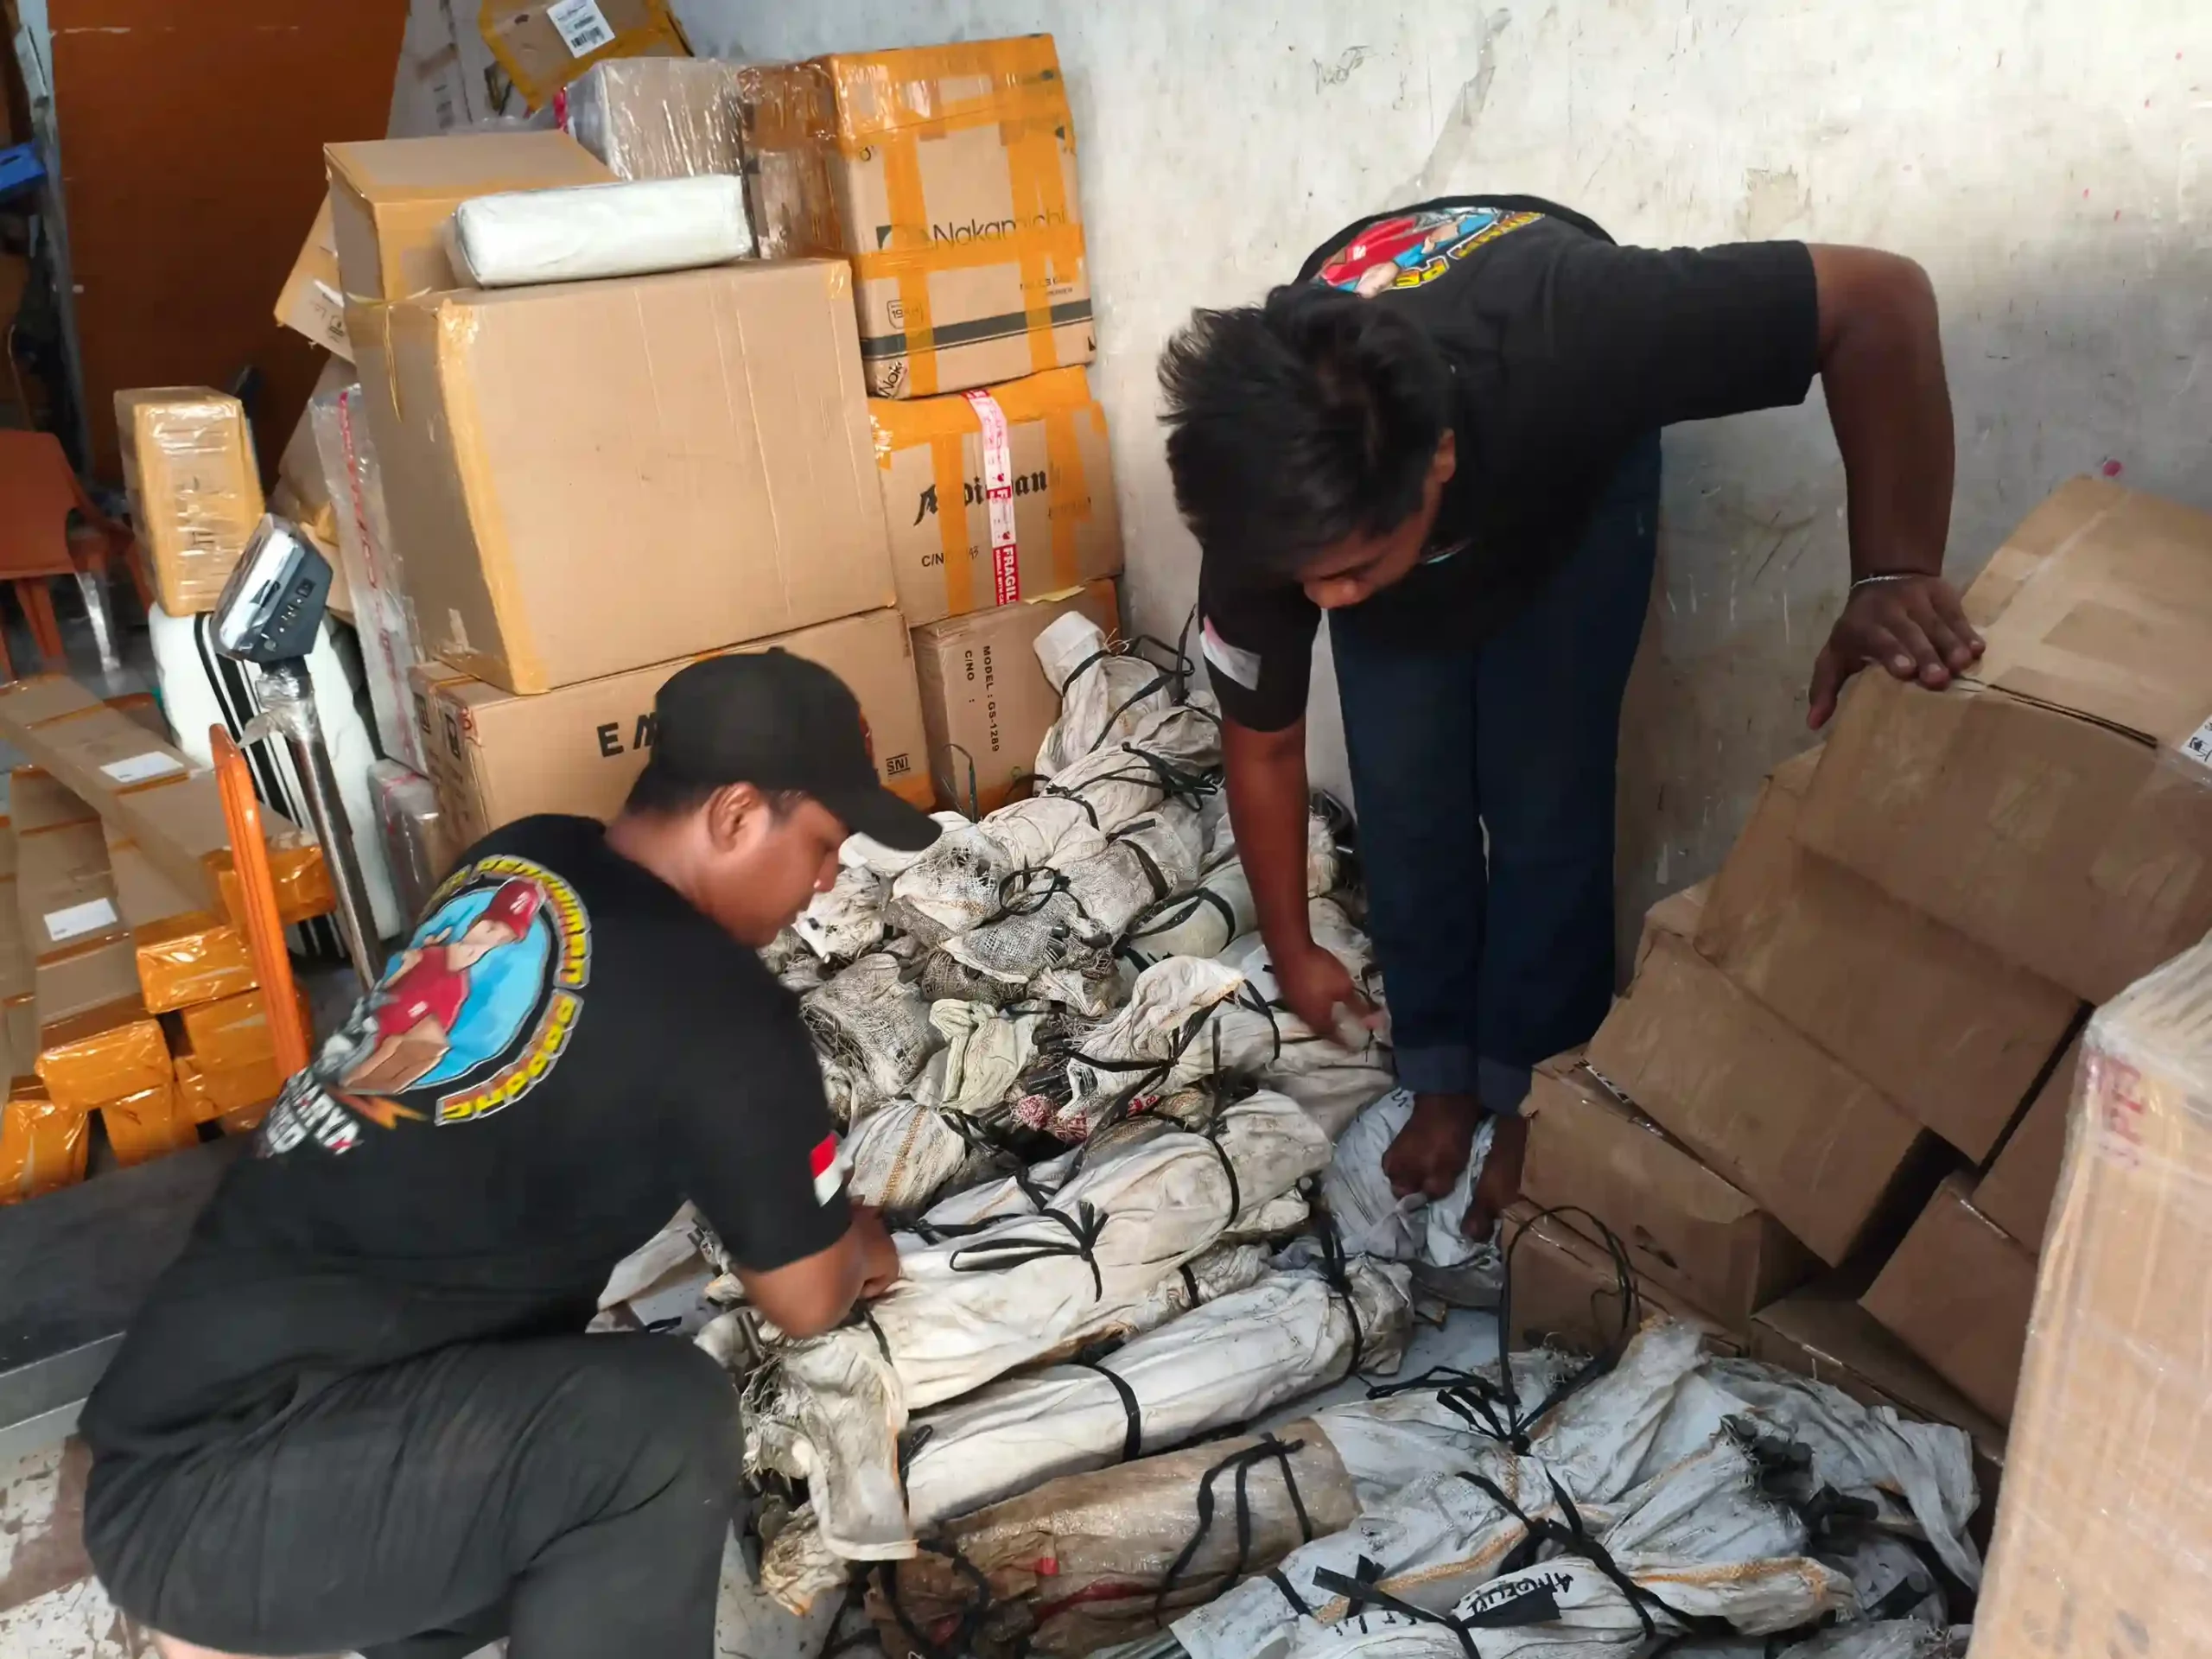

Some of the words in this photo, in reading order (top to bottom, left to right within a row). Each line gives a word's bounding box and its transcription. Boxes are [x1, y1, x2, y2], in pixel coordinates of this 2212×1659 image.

[1002, 546, 1017, 603] FRAGIL
[964, 650, 975, 681] C/NO
[983, 645, 994, 690] MODEL
[988, 701, 1000, 753] GS-1289
[887, 756, 908, 772] SNI
